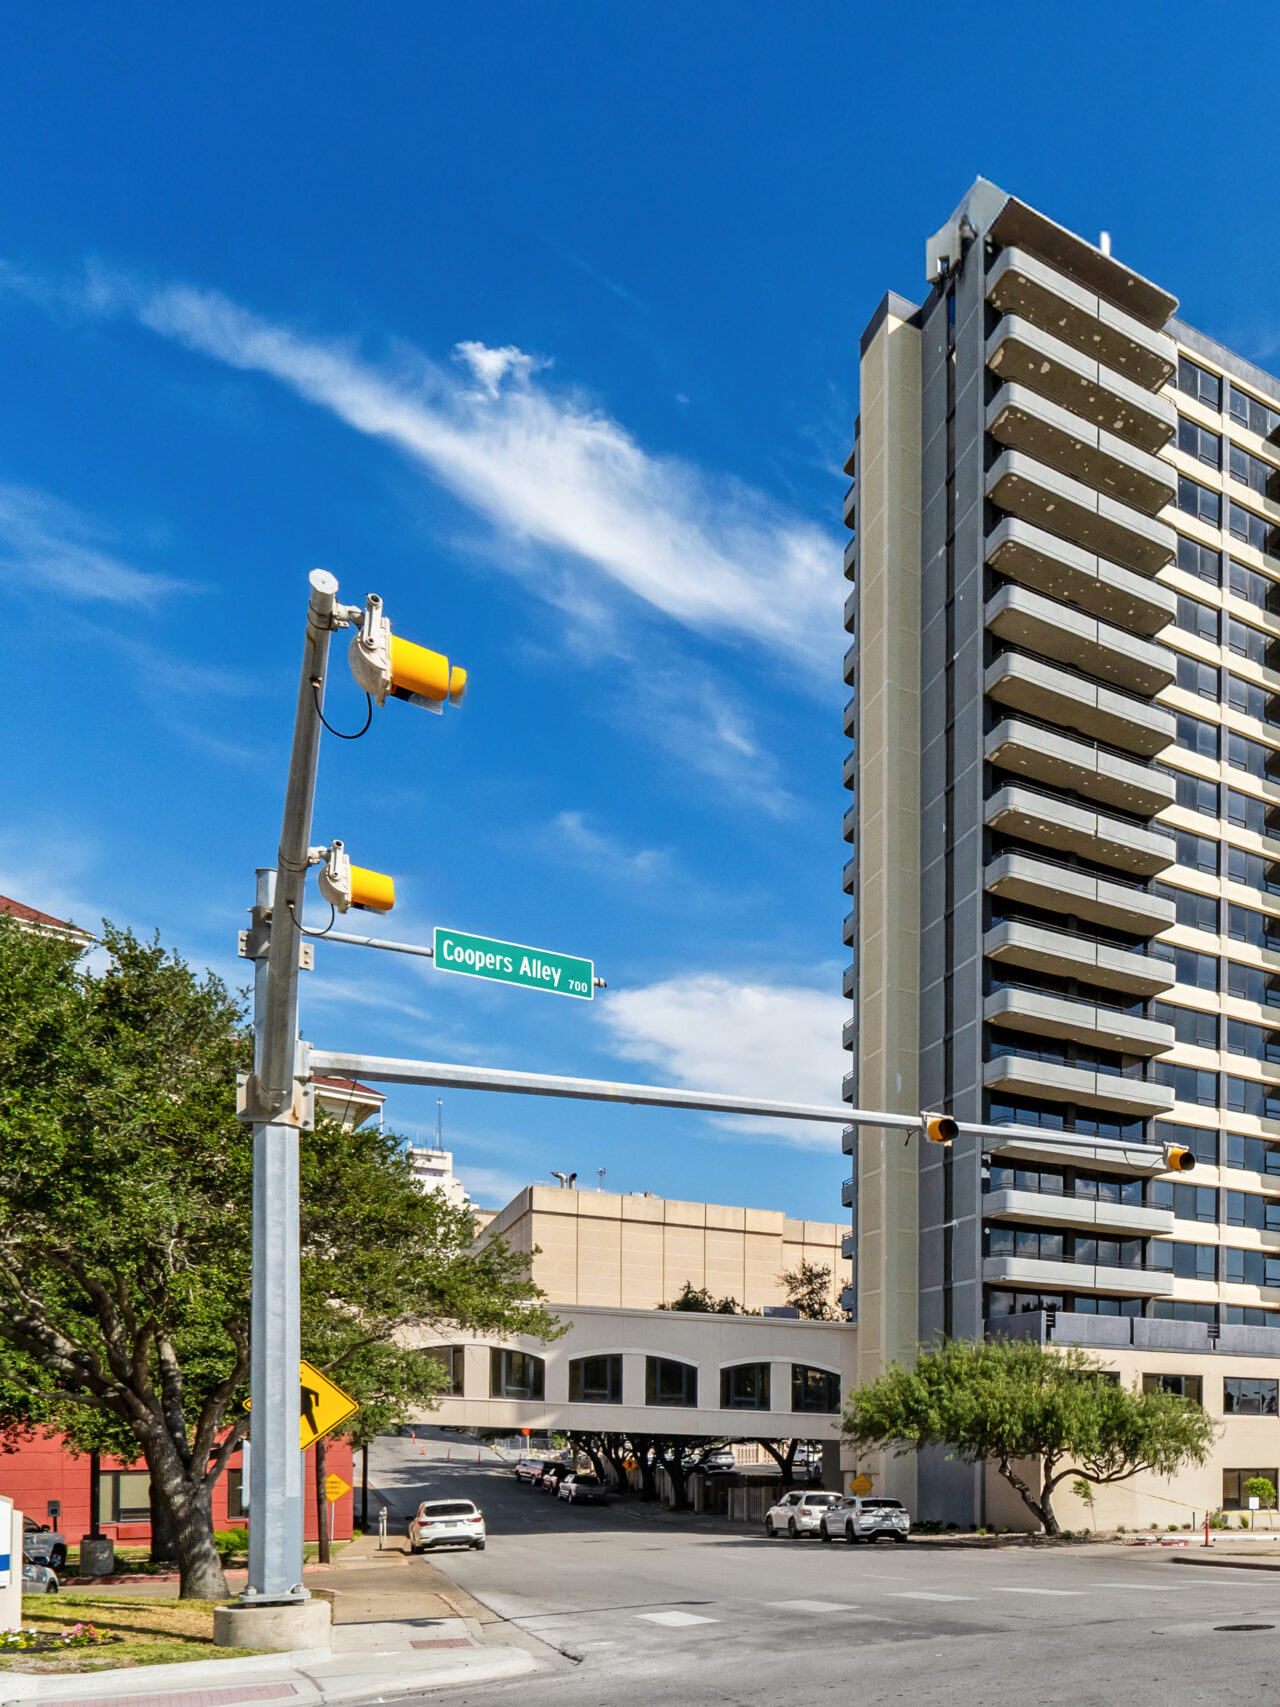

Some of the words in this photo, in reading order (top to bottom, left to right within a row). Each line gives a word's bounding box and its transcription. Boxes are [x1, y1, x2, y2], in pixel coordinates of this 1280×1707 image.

[443, 940, 513, 973] Coopers
[519, 956, 562, 987] Alley
[568, 979, 588, 993] 700
